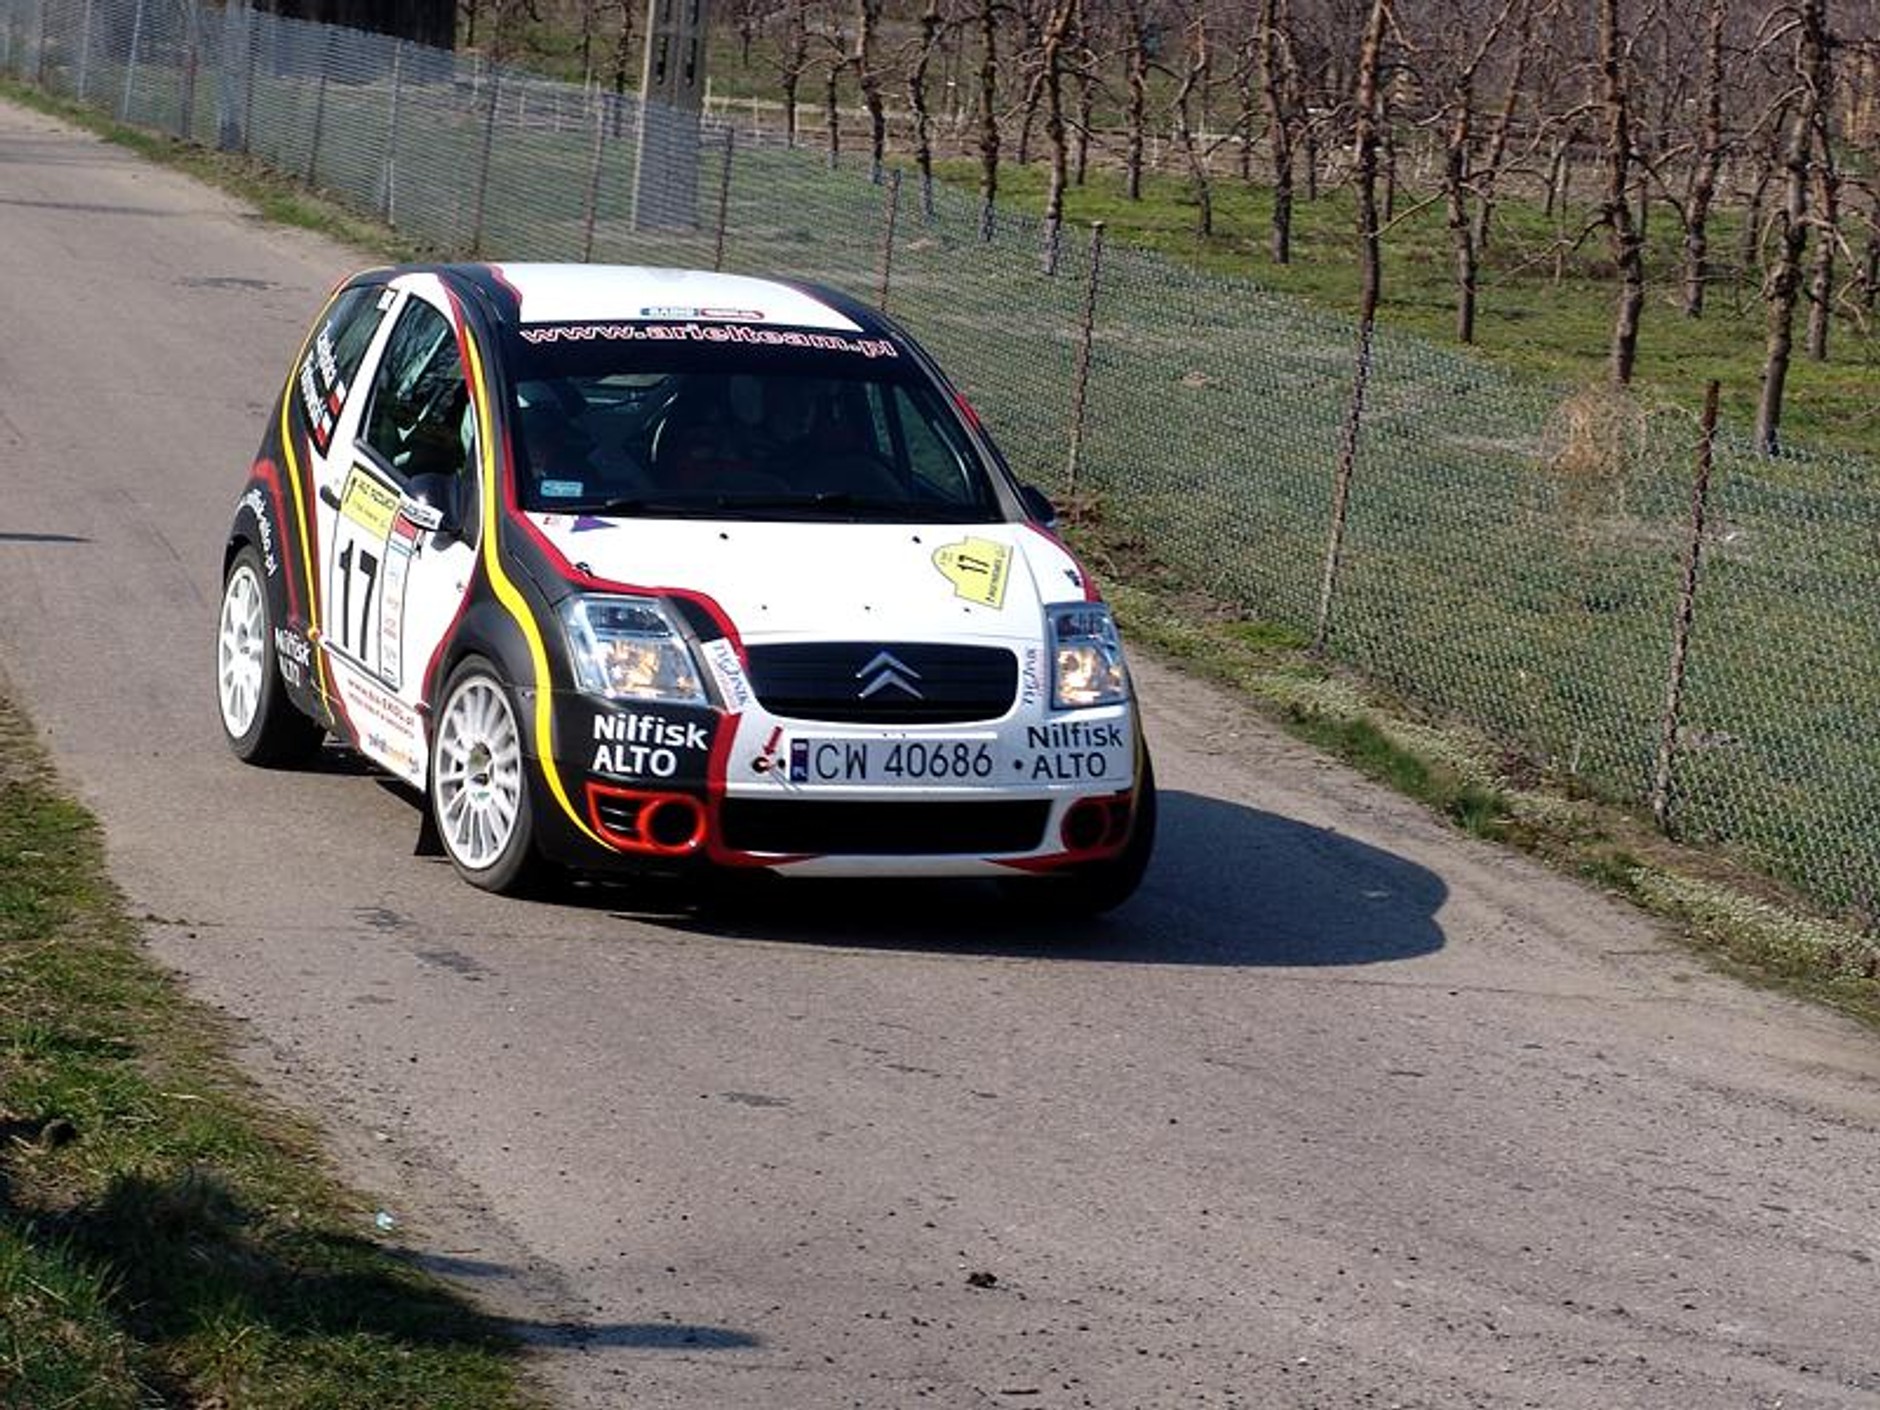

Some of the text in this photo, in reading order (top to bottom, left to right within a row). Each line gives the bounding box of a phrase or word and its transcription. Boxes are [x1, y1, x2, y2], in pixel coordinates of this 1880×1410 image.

[957, 555, 990, 575] 17
[336, 538, 379, 661] 17
[593, 713, 709, 750] Nilfisk
[1028, 722, 1124, 749] Nilfisk
[592, 745, 678, 777] ALTO
[814, 741, 993, 780] CW 40686
[1031, 752, 1107, 780] ALTO
